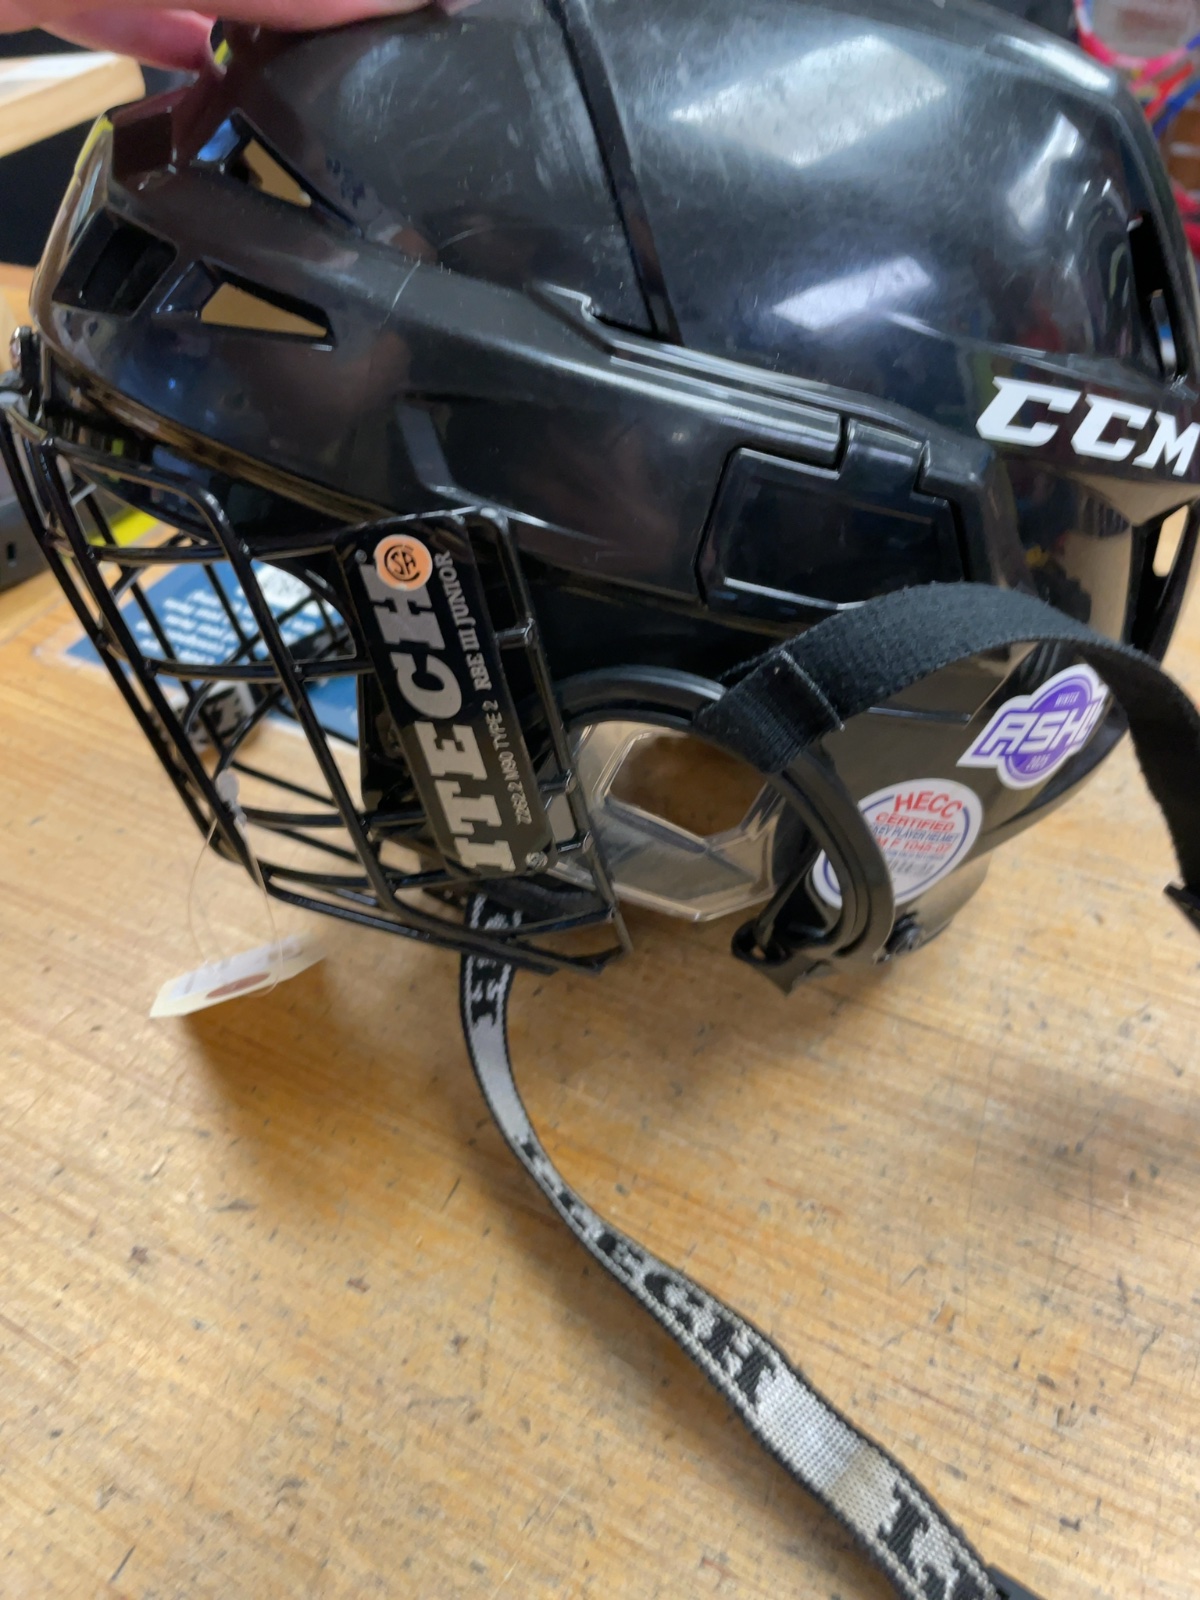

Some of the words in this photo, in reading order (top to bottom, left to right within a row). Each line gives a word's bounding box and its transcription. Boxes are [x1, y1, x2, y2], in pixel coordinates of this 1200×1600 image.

[975, 376, 1200, 477] CCM
[435, 550, 477, 628] JUNIOR
[466, 652, 492, 692] RBE
[358, 564, 516, 872] ITECH
[1054, 691, 1081, 707] WINTER
[485, 712, 511, 752] TYPE
[875, 812, 956, 832] CERTIFIED
[893, 790, 963, 819] HECC
[891, 828, 927, 841] PLAYER
[925, 831, 960, 843] HELMET
